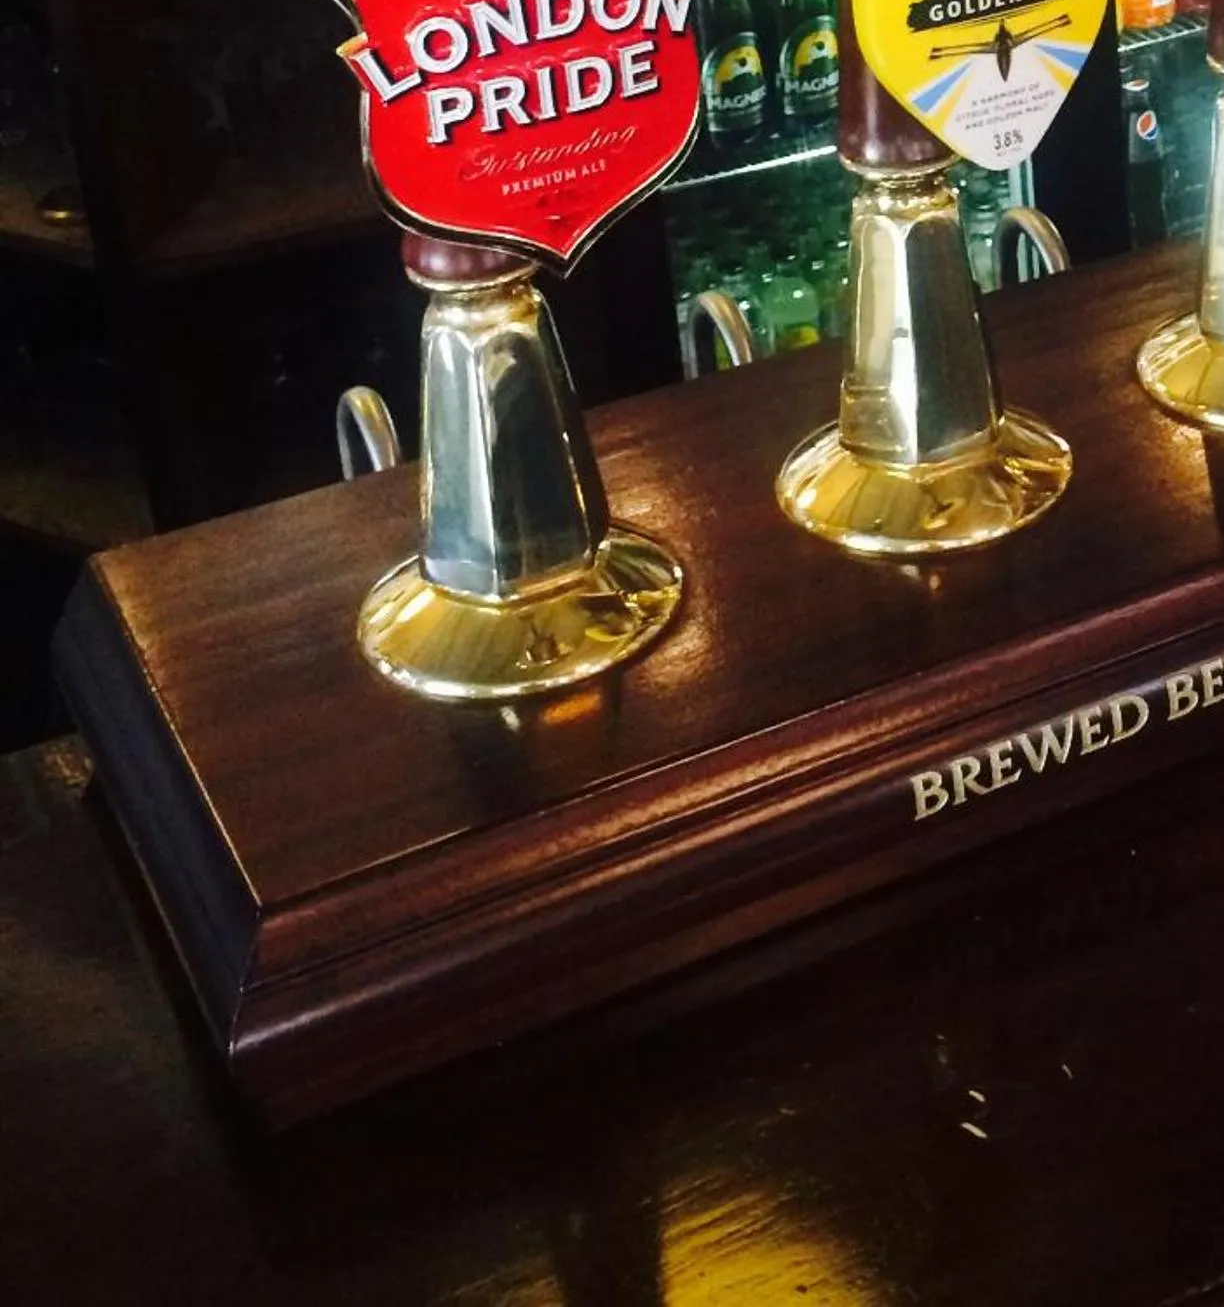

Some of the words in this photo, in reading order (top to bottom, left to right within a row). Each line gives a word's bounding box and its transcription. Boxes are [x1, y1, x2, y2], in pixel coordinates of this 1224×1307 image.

[425, 41, 660, 145] PRIDE
[502, 167, 577, 195] PREMIUM
[581, 159, 606, 178] ALE
[913, 688, 1150, 822] BREWED
